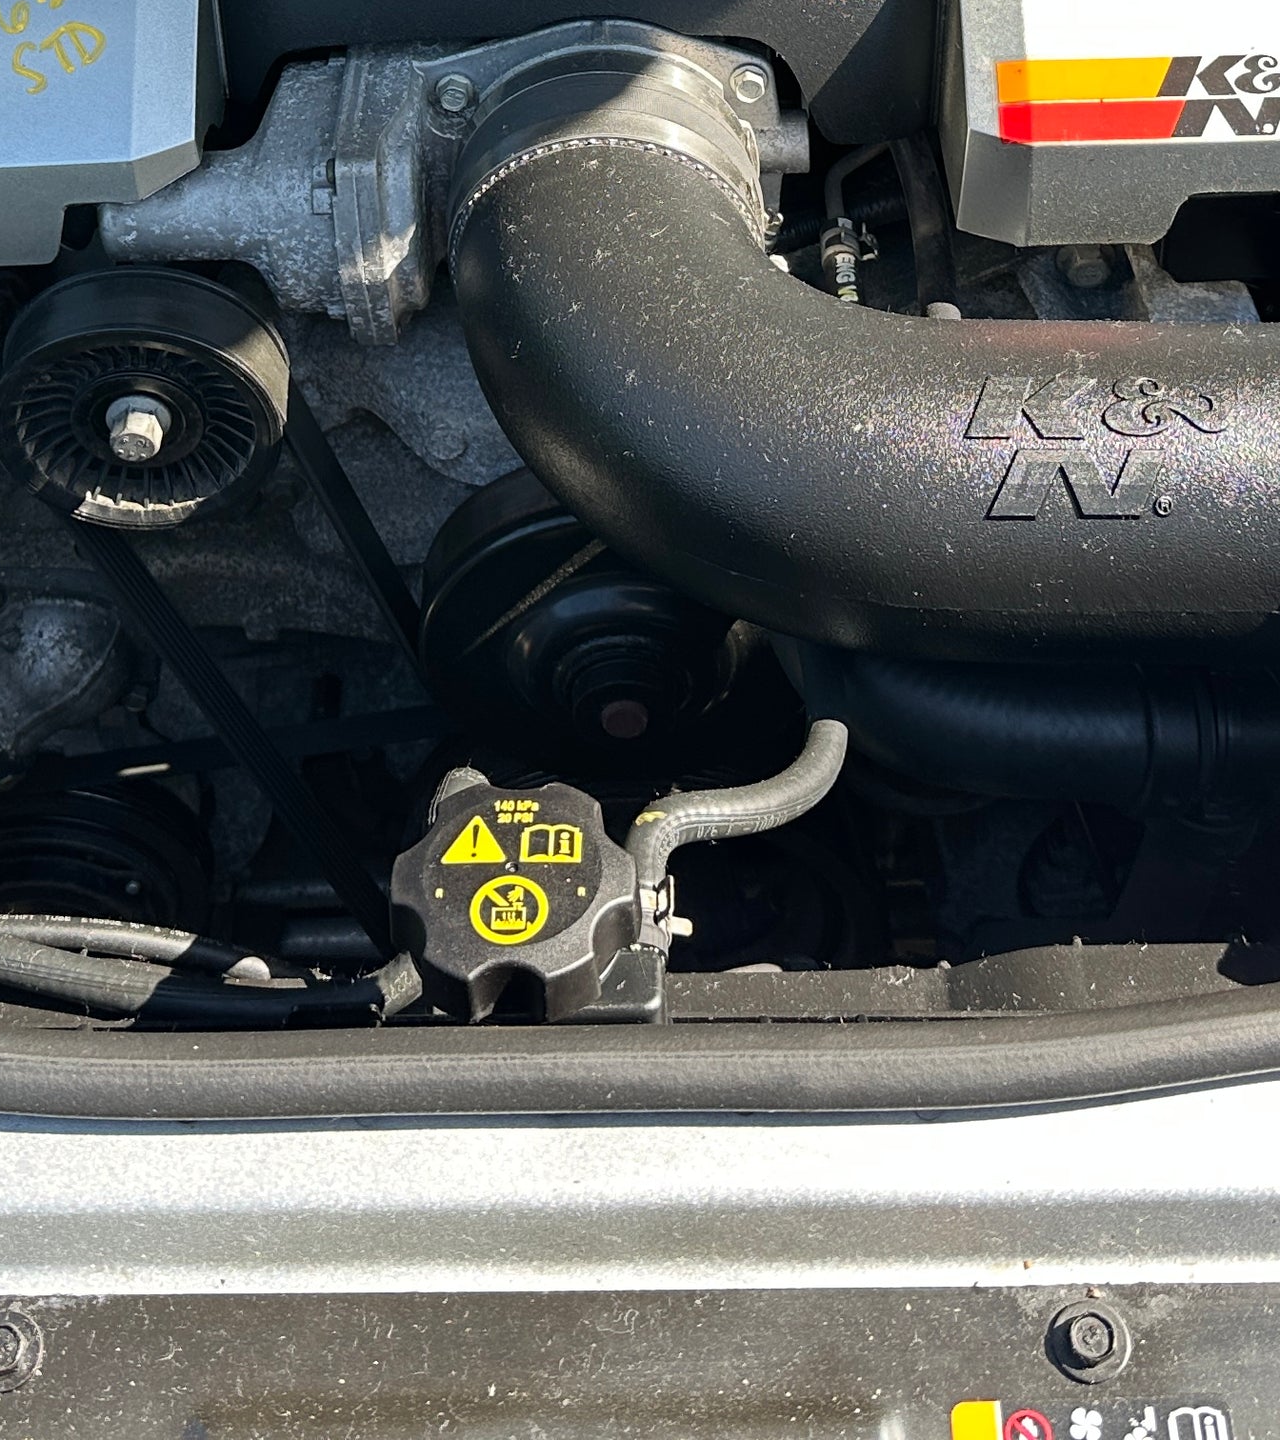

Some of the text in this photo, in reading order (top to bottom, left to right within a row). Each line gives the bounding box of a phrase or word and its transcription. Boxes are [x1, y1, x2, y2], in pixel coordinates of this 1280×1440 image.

[12, 20, 107, 95] STD
[834, 252, 856, 284] ENG
[494, 799, 515, 812] 140
[497, 812, 534, 824] 20 PSI
